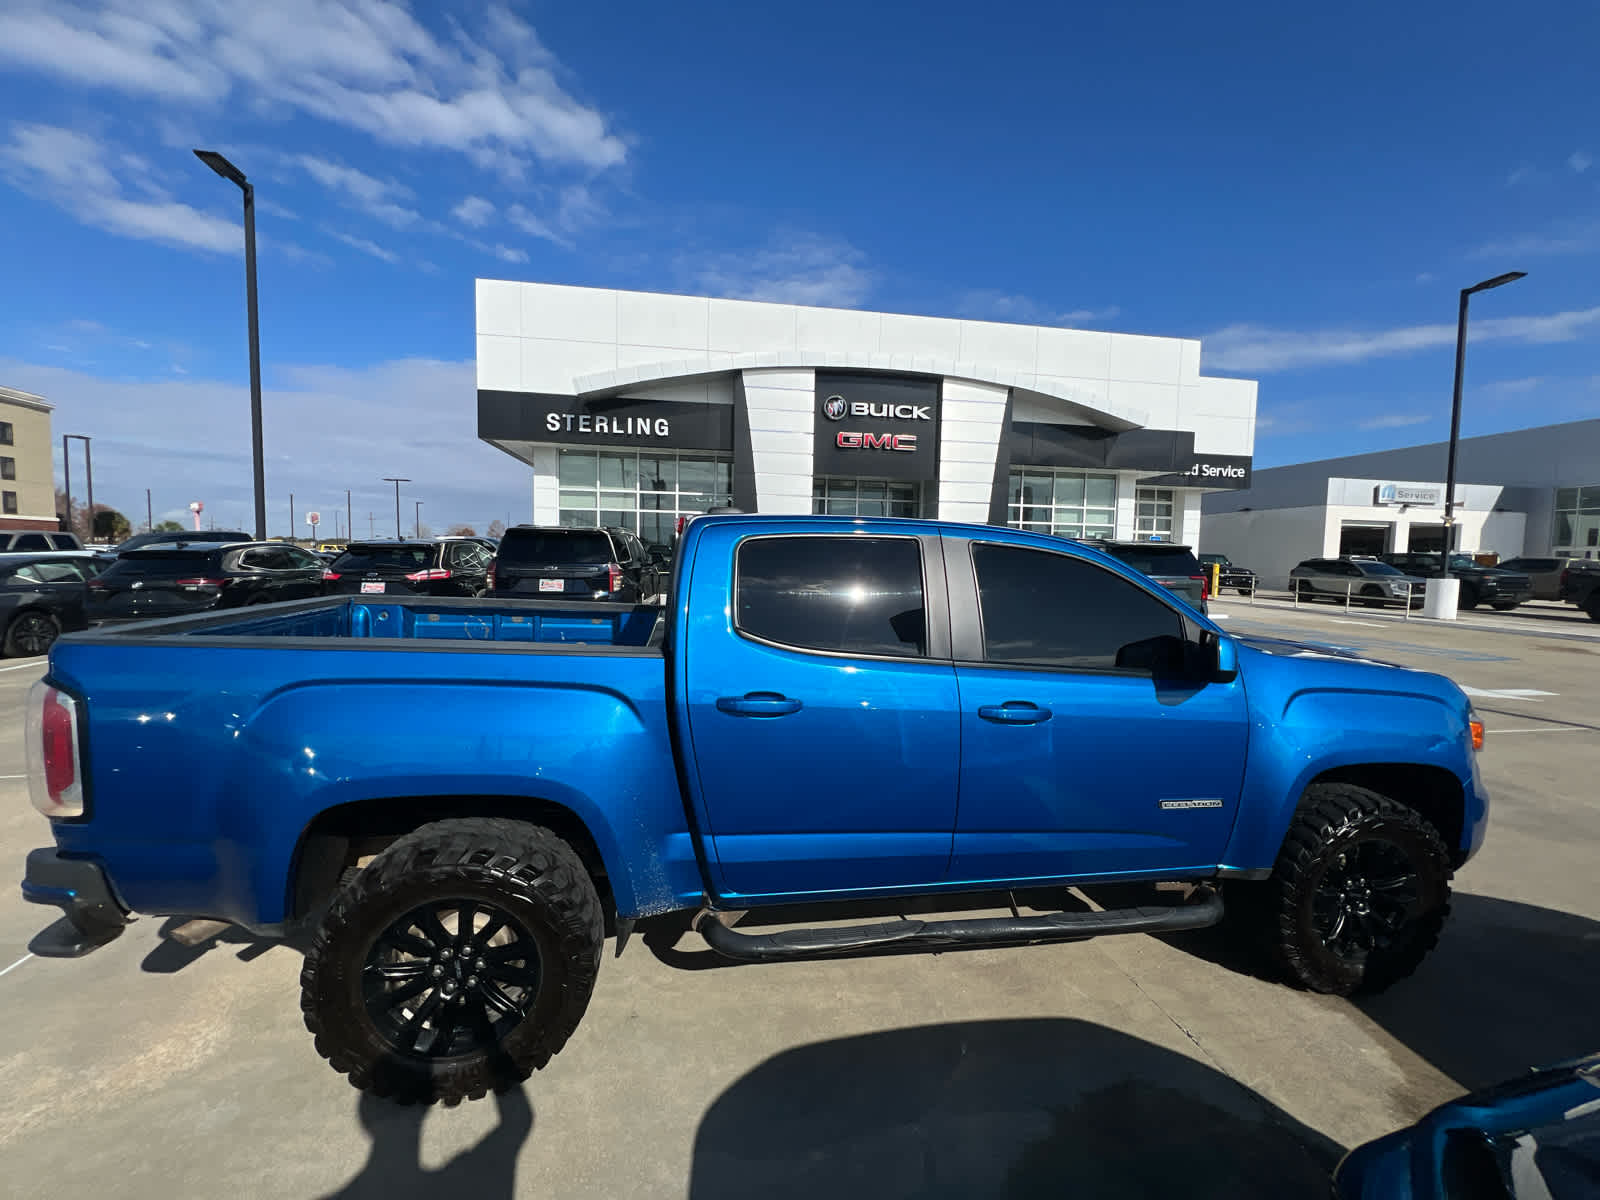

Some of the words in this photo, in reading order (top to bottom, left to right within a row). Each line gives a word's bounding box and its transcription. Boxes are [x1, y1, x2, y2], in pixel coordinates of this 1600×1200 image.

[851, 402, 931, 420] BUICK
[546, 412, 669, 437] STERLING
[837, 431, 917, 451] GMC
[1201, 464, 1246, 478] Service
